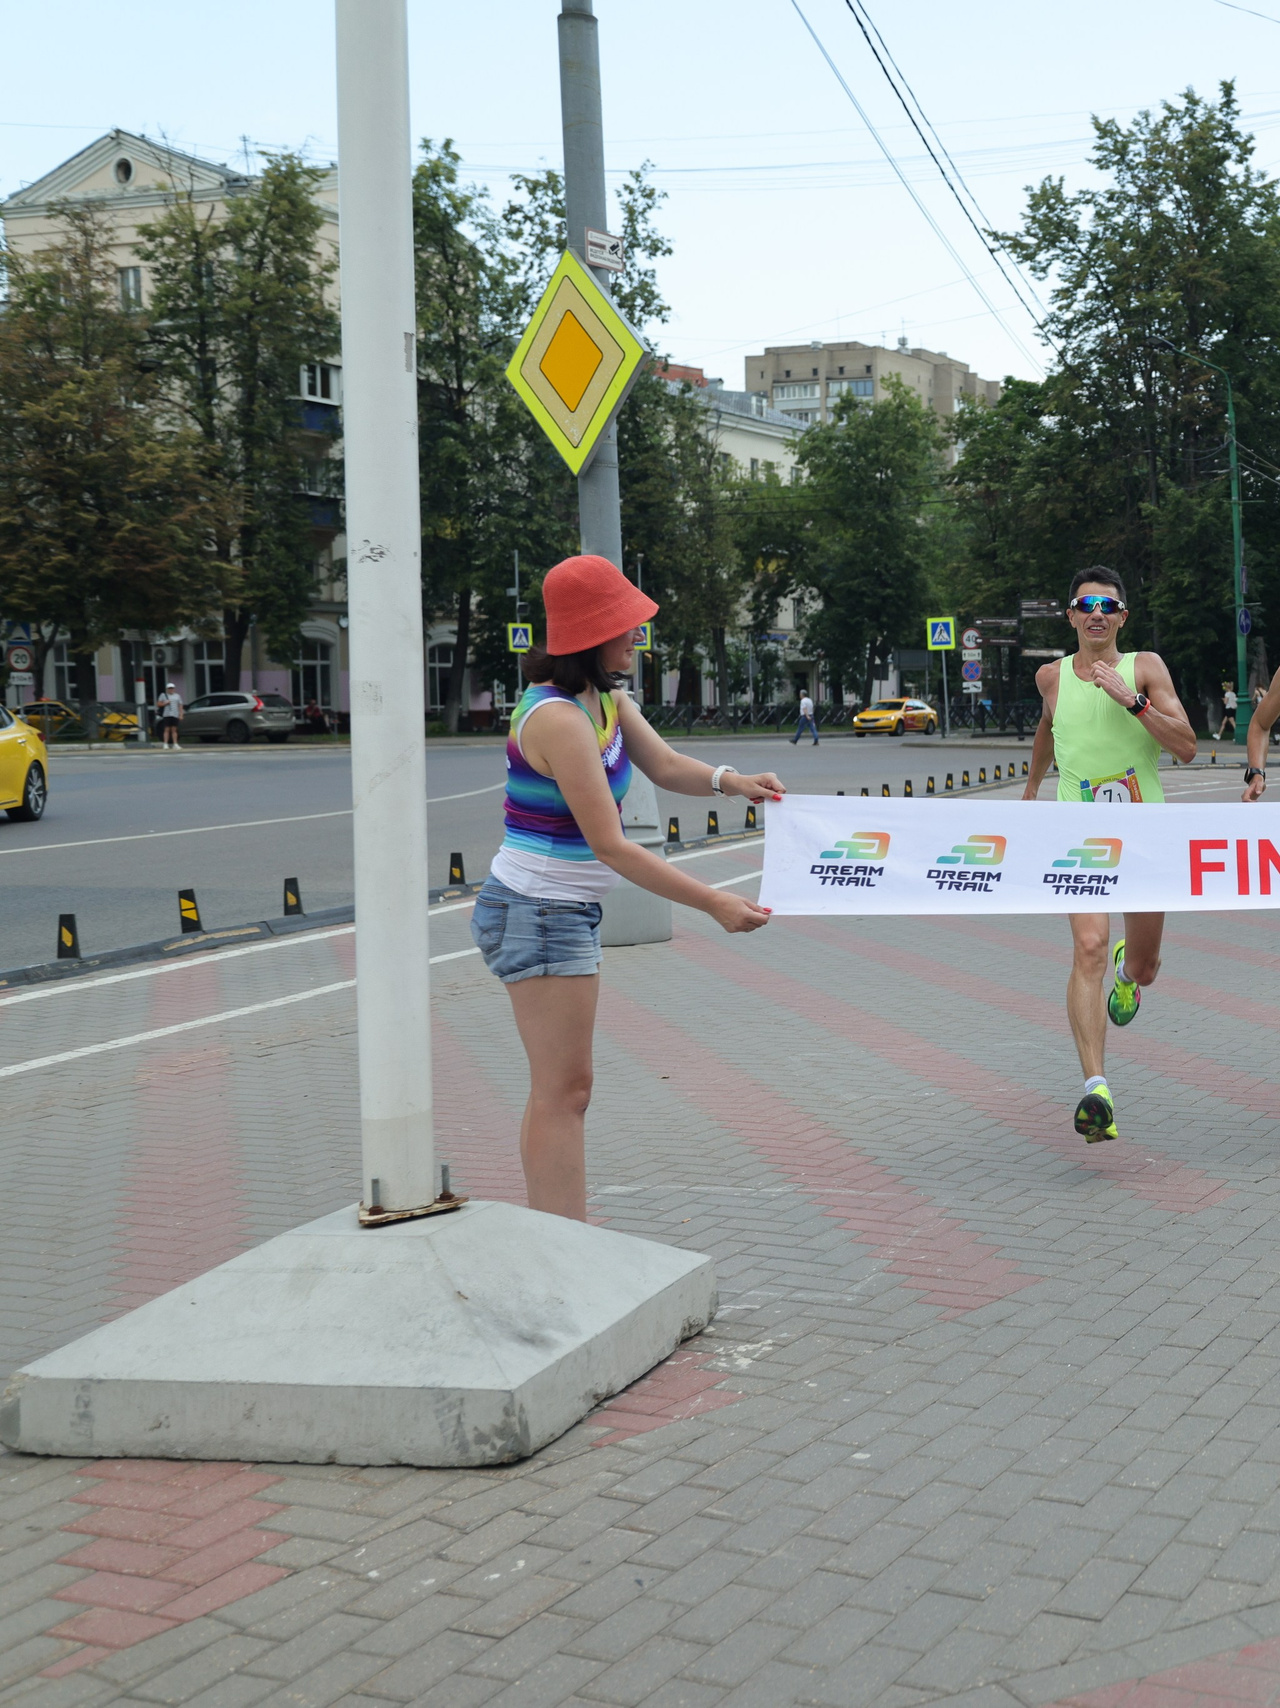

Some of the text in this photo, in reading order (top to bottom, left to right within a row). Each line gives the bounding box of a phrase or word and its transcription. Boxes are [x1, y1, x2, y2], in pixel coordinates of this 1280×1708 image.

[13, 653, 28, 664] 20
[1102, 788, 1113, 803] 7
[810, 864, 884, 876] DREAM
[926, 869, 1002, 882] DREAM
[819, 876, 876, 887] TRAIL
[1043, 873, 1119, 885] DREAM
[935, 880, 994, 893] TRAIL
[1052, 885, 1110, 896] TRAIL
